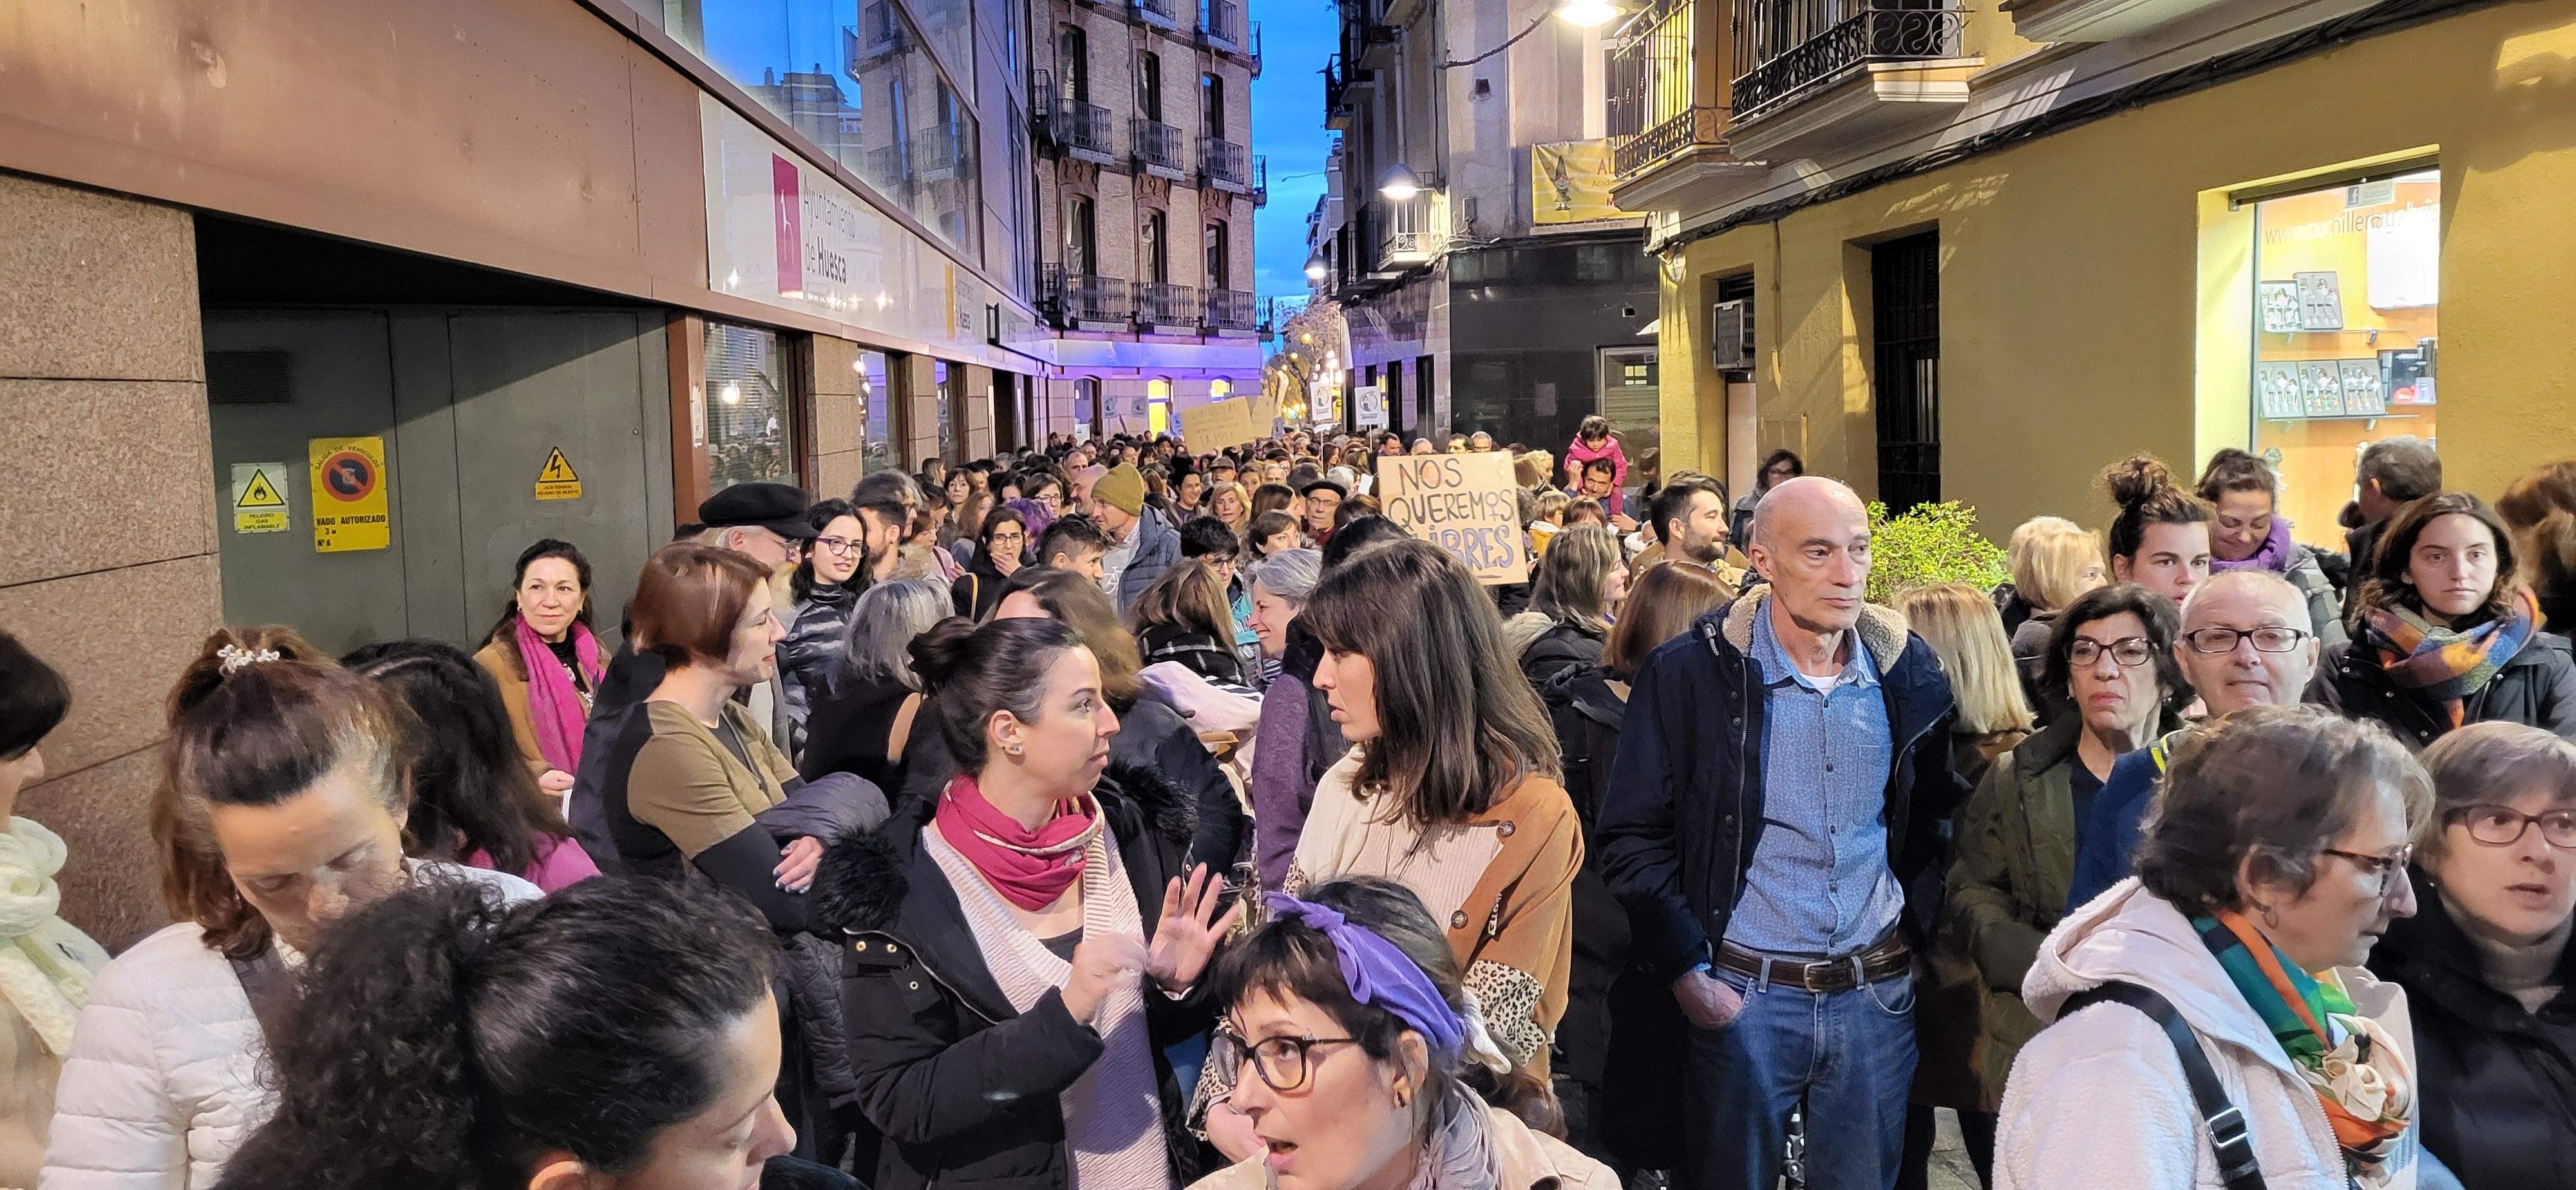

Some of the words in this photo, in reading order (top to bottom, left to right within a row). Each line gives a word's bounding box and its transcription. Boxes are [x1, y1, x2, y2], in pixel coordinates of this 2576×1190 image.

[1597, 157, 1615, 175] AL
[804, 173, 856, 238] Ayuntamiento
[805, 231, 815, 273] de
[817, 236, 846, 284] Huesca
[315, 451, 332, 469] SALIDA
[348, 446, 381, 468] VEHICULOS
[1398, 457, 1463, 495] NOS
[316, 516, 336, 525] VADO
[341, 515, 386, 524] AUTORIZADO
